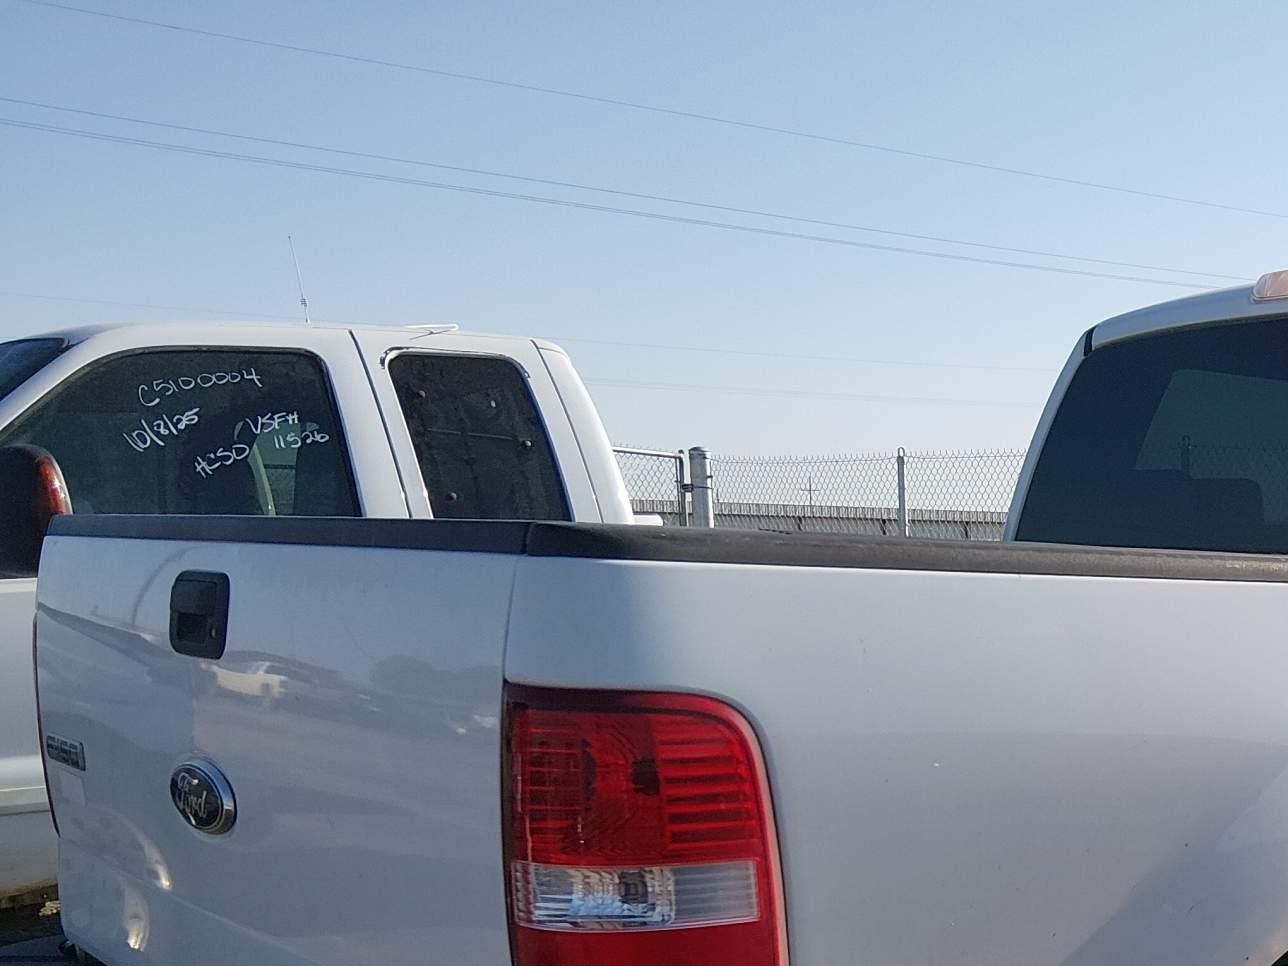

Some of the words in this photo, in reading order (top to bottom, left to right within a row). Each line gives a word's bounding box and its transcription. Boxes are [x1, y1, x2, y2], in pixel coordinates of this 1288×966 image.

[138, 367, 263, 406] C5100004
[123, 408, 200, 452] 10/8/25
[273, 431, 330, 449] 11526
